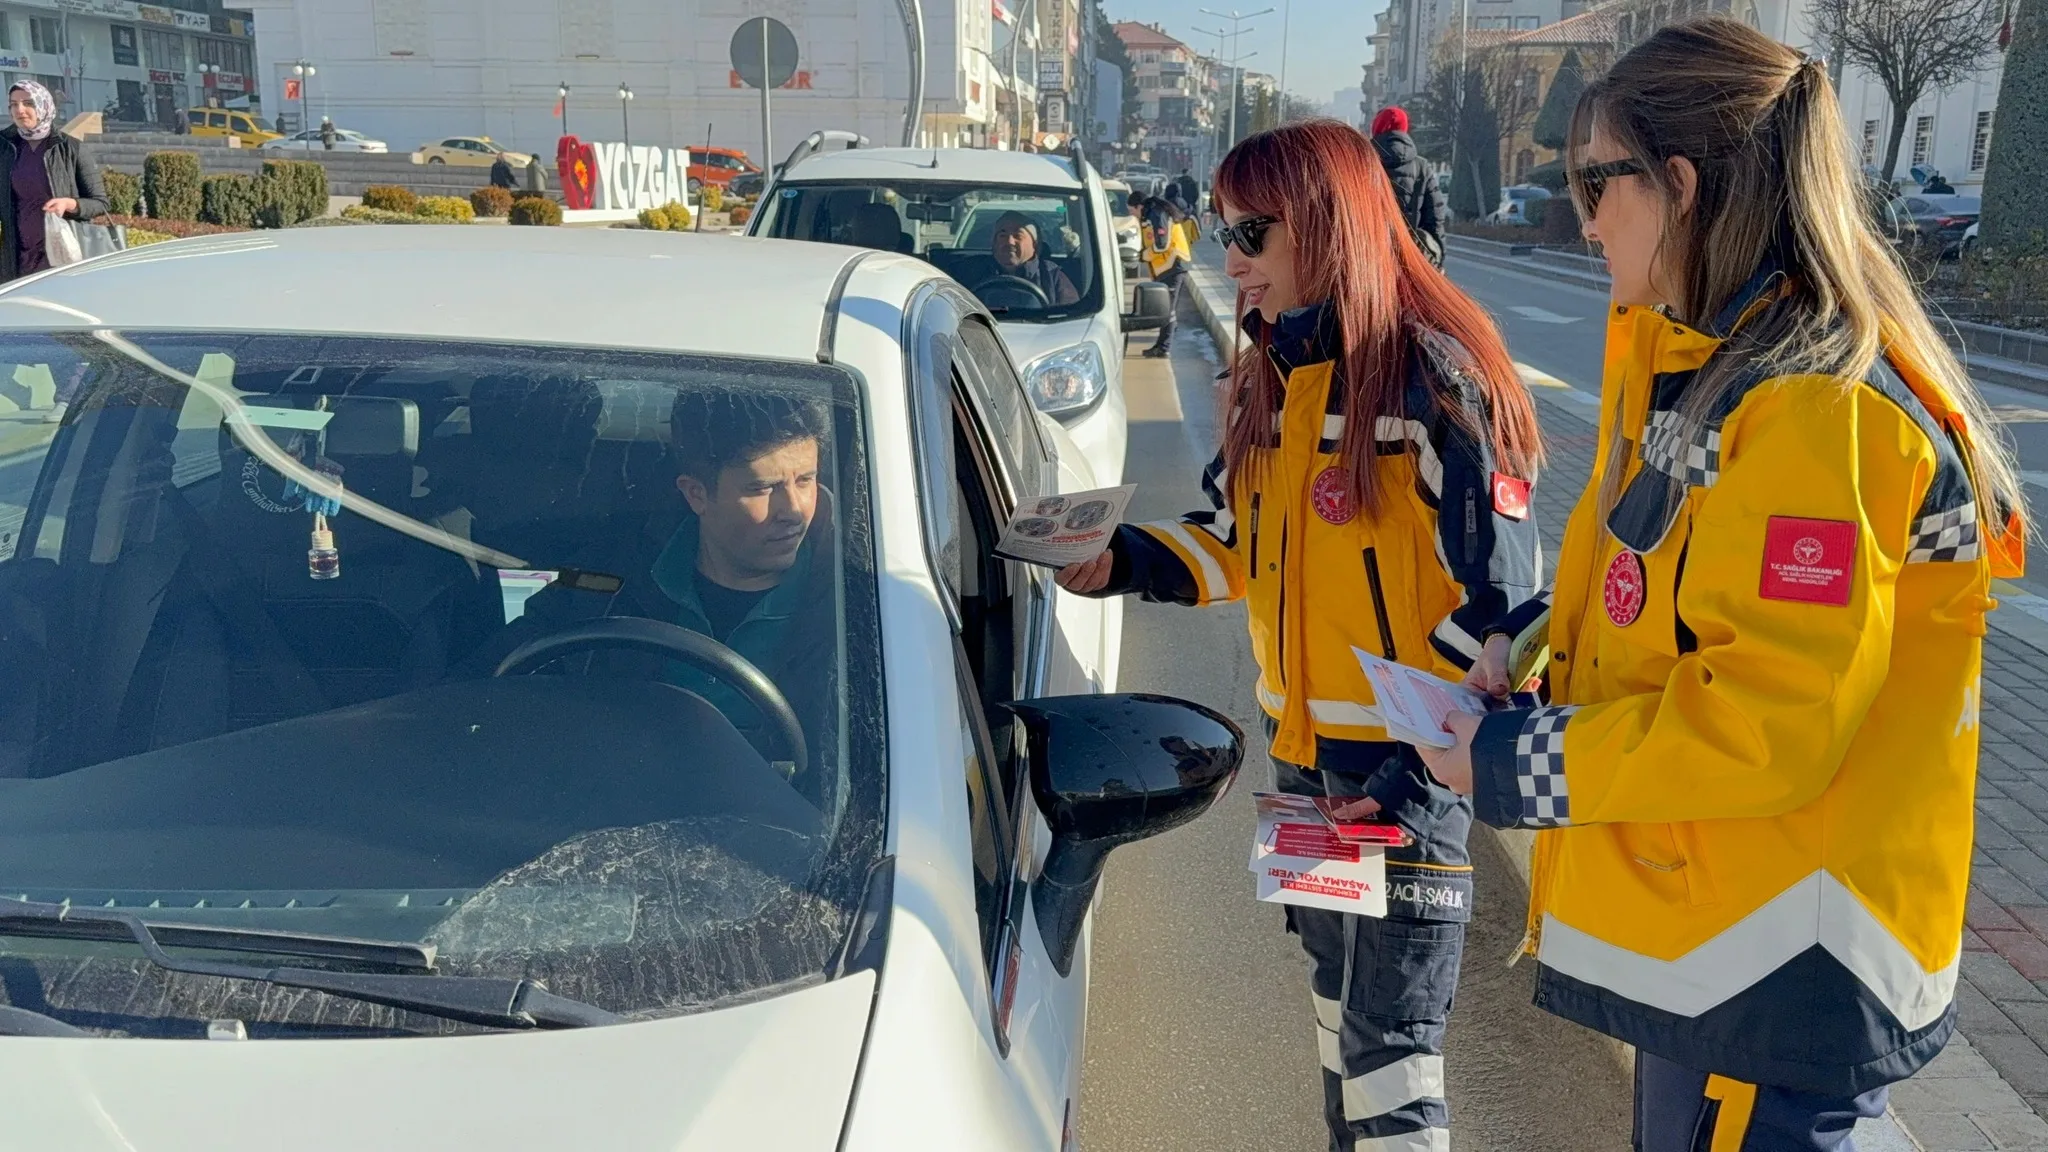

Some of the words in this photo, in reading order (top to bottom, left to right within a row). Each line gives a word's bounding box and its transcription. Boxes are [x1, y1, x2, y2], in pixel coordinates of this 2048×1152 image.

[593, 141, 691, 210] YOZGAT
[1770, 562, 1782, 570] T.C.
[1783, 564, 1806, 572] SAĞLIK
[1807, 566, 1843, 576] BAKANLIĞI
[1267, 867, 1296, 880] VER!
[1297, 872, 1321, 884] YOL
[1283, 880, 1295, 890] İLE
[1295, 882, 1322, 894] SİSTEMİ
[1322, 875, 1372, 892] YAŞAMA
[1323, 887, 1358, 899] FERMUAR
[1392, 881, 1424, 903] ACİL
[1425, 886, 1464, 909] SAĞLIK
